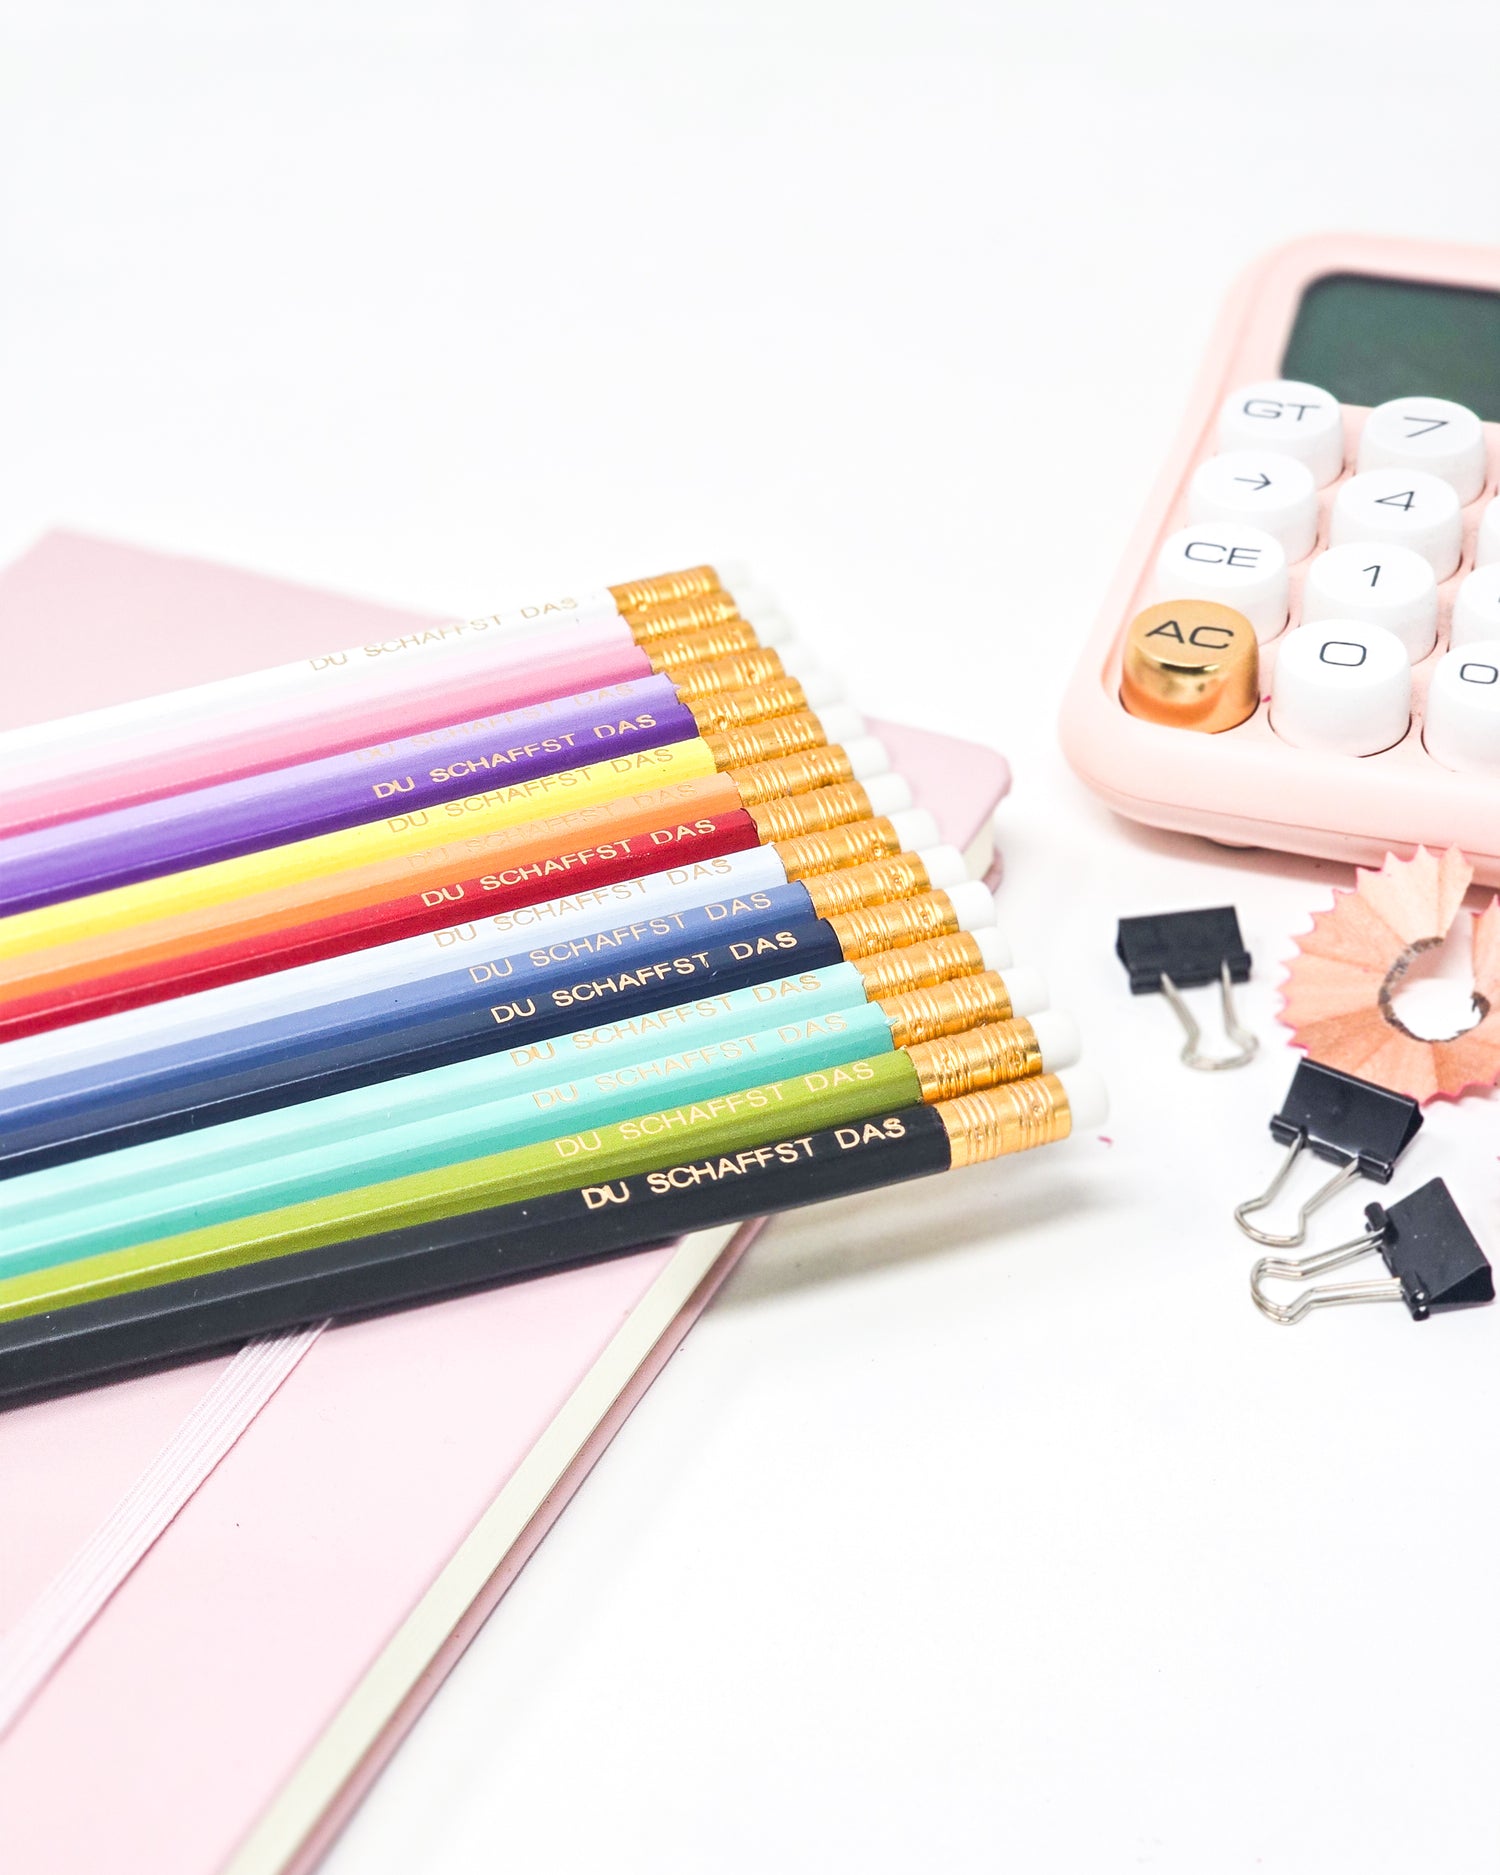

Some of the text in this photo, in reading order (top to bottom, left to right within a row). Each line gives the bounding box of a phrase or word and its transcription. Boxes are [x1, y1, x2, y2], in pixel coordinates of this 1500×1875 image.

[1243, 399, 1321, 422] GT
[1404, 416, 1449, 438] 7
[1374, 490, 1416, 511] 4
[1184, 541, 1262, 568] CE
[1362, 565, 1382, 587] 1
[309, 597, 579, 671] DU SCHAFFST DAS
[1145, 620, 1234, 649] AC
[372, 714, 657, 798] DU SCHAFFST DAS
[387, 748, 674, 833] DU SCHAFFST DAS
[406, 845, 449, 871] DU
[632, 782, 696, 809] DAS
[421, 819, 717, 907] DU SCHAFFST DAS
[434, 859, 733, 948] DU SCHAFFST DAS
[468, 893, 773, 984] DU SCHAFFST DAS
[490, 931, 798, 1024] DU SCHAFFST DAS
[510, 975, 822, 1067] DU SCHAFFST DAS
[532, 1014, 849, 1109] DU SCHAFFST DAS
[554, 1062, 875, 1157] DU SCHAFFST DAS
[581, 1118, 907, 1209] DU SCHAFFST DAS
